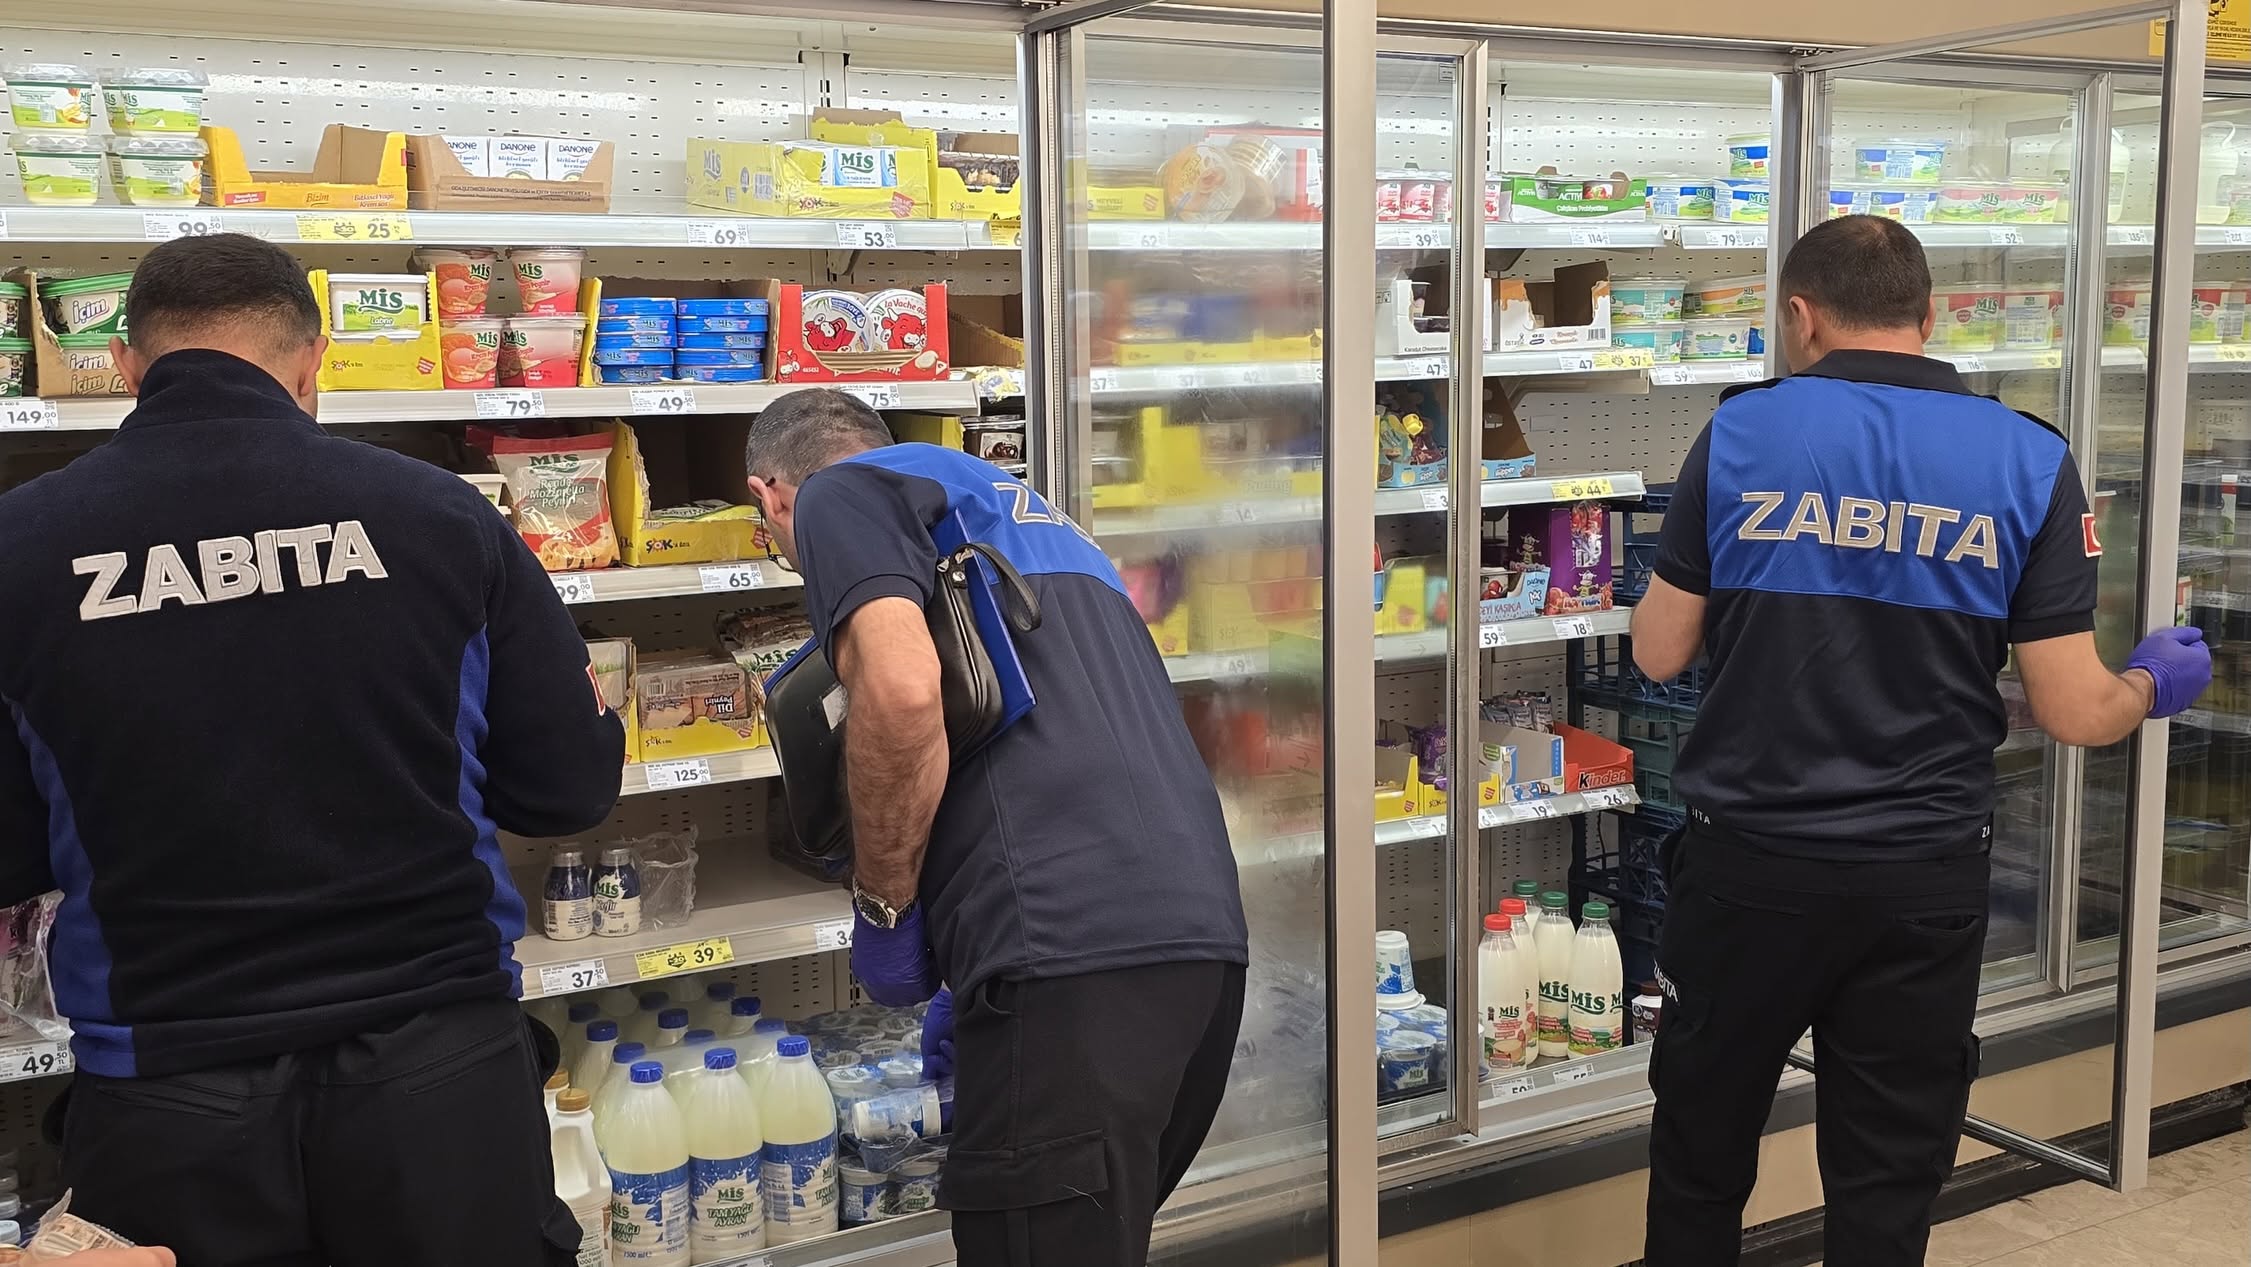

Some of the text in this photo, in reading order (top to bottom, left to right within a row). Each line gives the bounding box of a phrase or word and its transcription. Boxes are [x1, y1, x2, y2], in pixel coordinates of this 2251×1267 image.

[500, 142, 536, 152] DANONE
[558, 144, 594, 154] DANONE
[367, 223, 391, 239] 25
[714, 229, 737, 245] 69
[1587, 232, 1603, 244] 114
[2004, 232, 2018, 244] 52
[864, 231, 885, 247] 53
[1415, 233, 1432, 248] 39
[1721, 233, 1736, 247] 79
[884, 300, 893, 308] La
[893, 298, 917, 310] Vache
[1579, 359, 1593, 370] 47
[1629, 355, 1641, 366] 37
[1426, 363, 1441, 376] 47
[1674, 370, 1688, 382] 59
[1091, 376, 1107, 391] 37
[658, 396, 683, 412] 49
[868, 392, 889, 407] 75
[506, 400, 531, 416] 79
[6, 410, 42, 425] 149
[1586, 485, 1602, 496] 44
[1737, 490, 2000, 570] ZABITA
[72, 520, 389, 622] ZABITA
[728, 572, 752, 588] 65
[1572, 623, 1588, 636] 18
[1483, 632, 1499, 645] 59
[717, 701, 734, 714] Dil
[674, 768, 699, 782] 125
[1578, 768, 1624, 790] Kinder
[1603, 793, 1623, 806] 26
[1531, 804, 1548, 818] 19
[693, 947, 715, 964] 39
[572, 970, 593, 988] 37
[22, 1053, 54, 1074] 49
[707, 1207, 732, 1219] TAM
[714, 1214, 748, 1228] AYRAN
